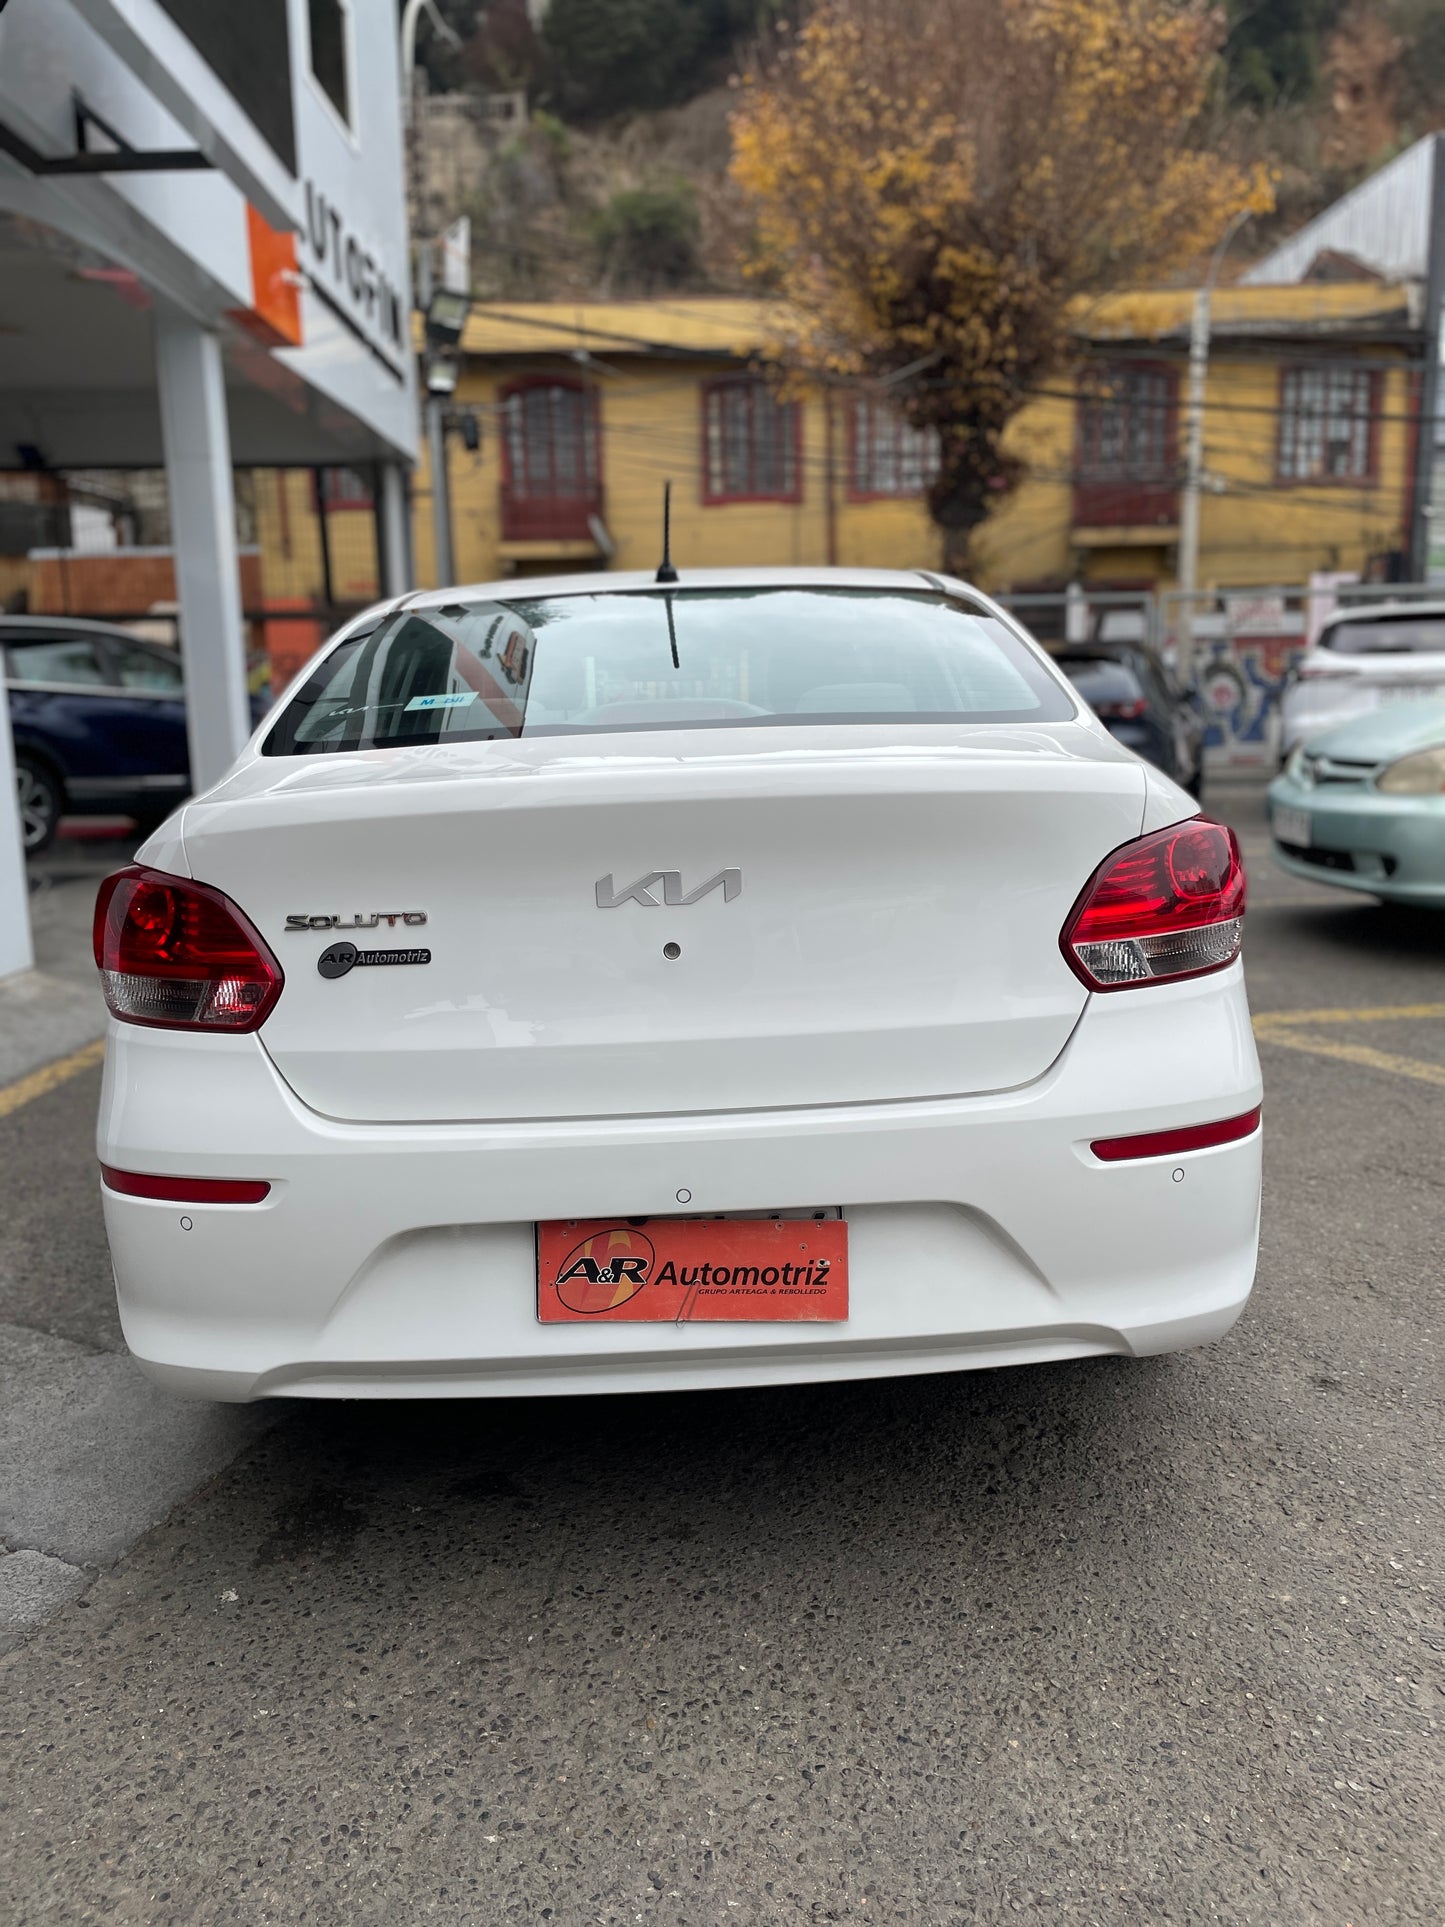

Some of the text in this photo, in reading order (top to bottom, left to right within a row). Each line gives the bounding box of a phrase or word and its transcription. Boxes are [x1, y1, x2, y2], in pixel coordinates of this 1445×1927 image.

[595, 866, 742, 909] KIA
[284, 909, 429, 932] SOLUTO
[356, 949, 429, 965] Automotriz
[555, 1256, 831, 1286] A&R Automotriz
